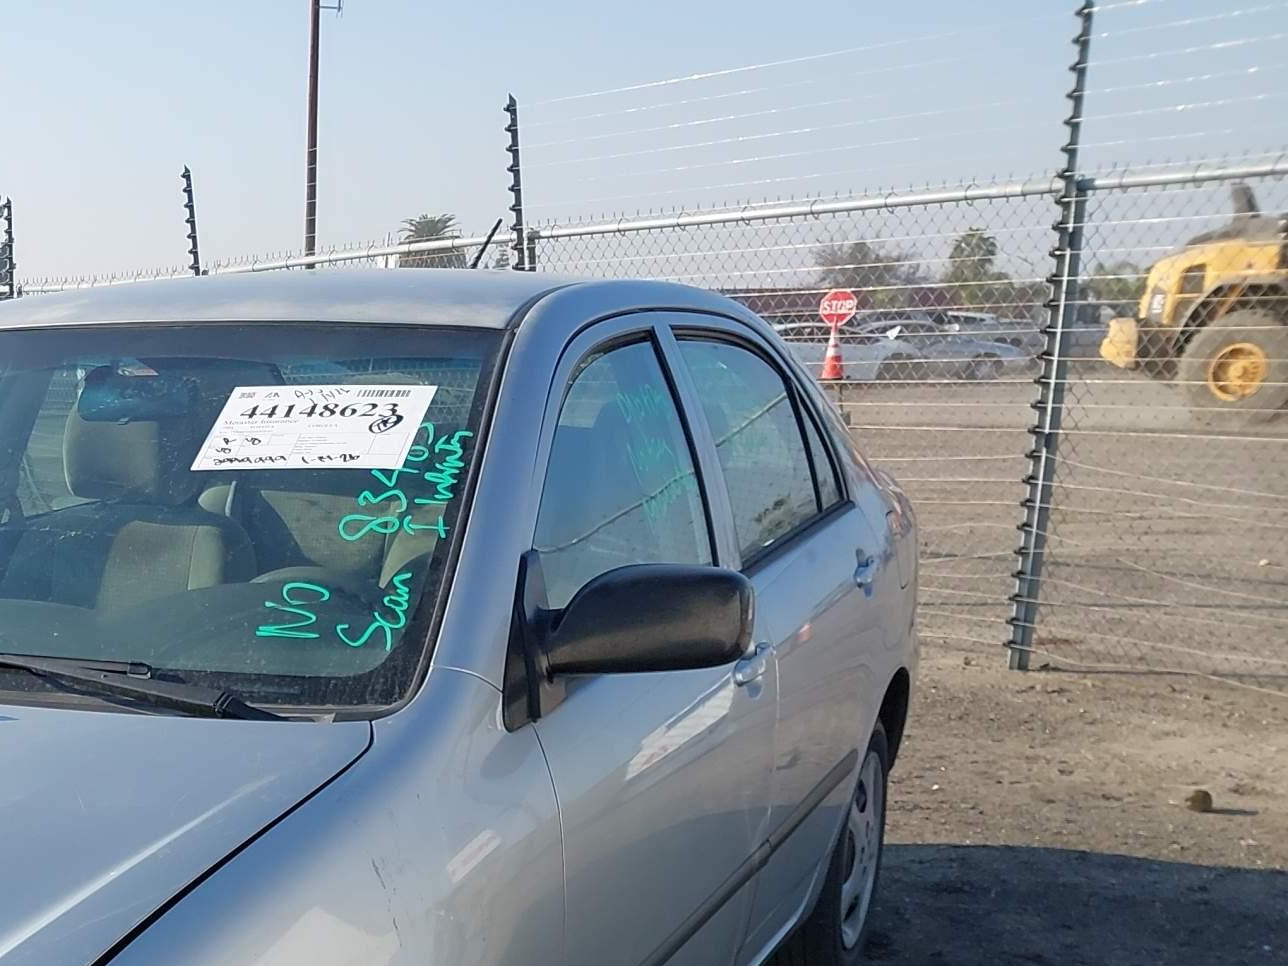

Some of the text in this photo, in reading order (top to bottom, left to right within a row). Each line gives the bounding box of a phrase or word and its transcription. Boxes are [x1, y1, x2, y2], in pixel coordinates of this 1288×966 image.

[822, 298, 854, 314] STOP
[239, 402, 400, 419] 44148623
[335, 572, 413, 652] Scan
